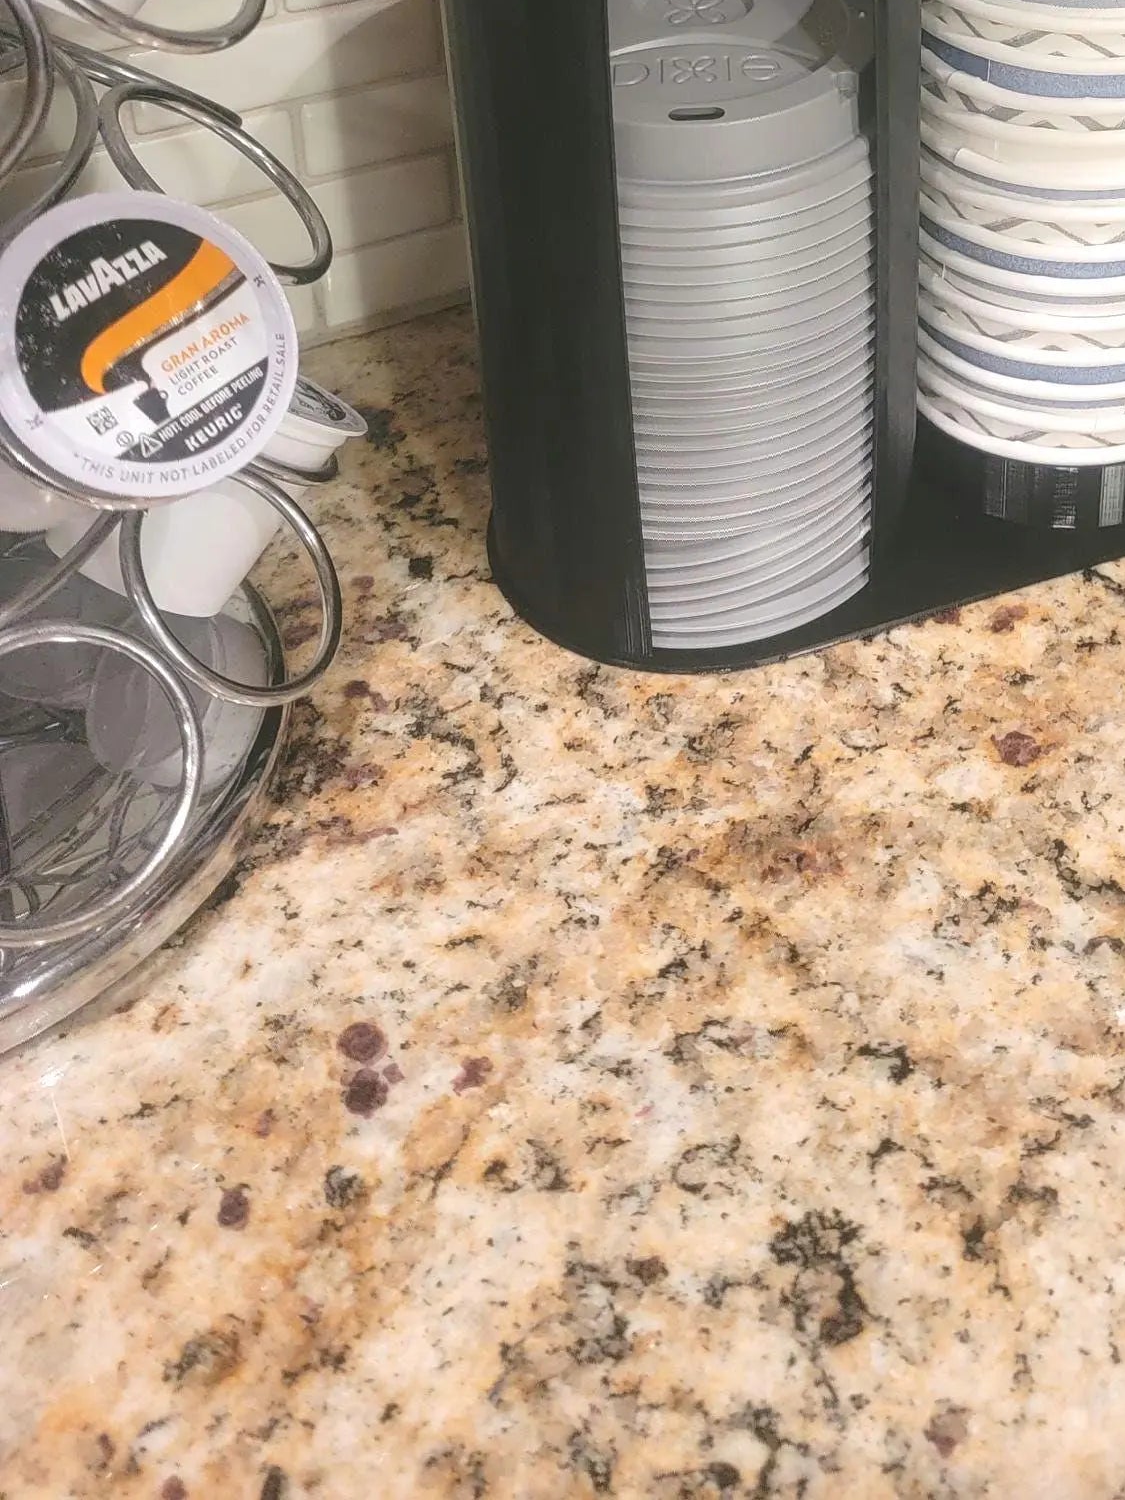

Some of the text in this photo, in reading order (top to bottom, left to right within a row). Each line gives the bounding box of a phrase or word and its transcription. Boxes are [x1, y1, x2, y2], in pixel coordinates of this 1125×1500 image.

[48, 240, 169, 322] LAVAZZA
[160, 314, 249, 373] GRAN AROMA
[168, 336, 238, 387] LIGHT ROAST
[120, 469, 154, 485] UNIT
[159, 467, 188, 484] NOT
[193, 437, 246, 477] LABELED
[247, 414, 266, 439] FOR
[263, 370, 284, 413] RETAIL
[275, 332, 286, 366] SALE
[177, 365, 219, 396] COFFEE
[182, 411, 202, 428] COOL
[201, 389, 234, 415] BEFORE
[232, 367, 264, 395] PEELING
